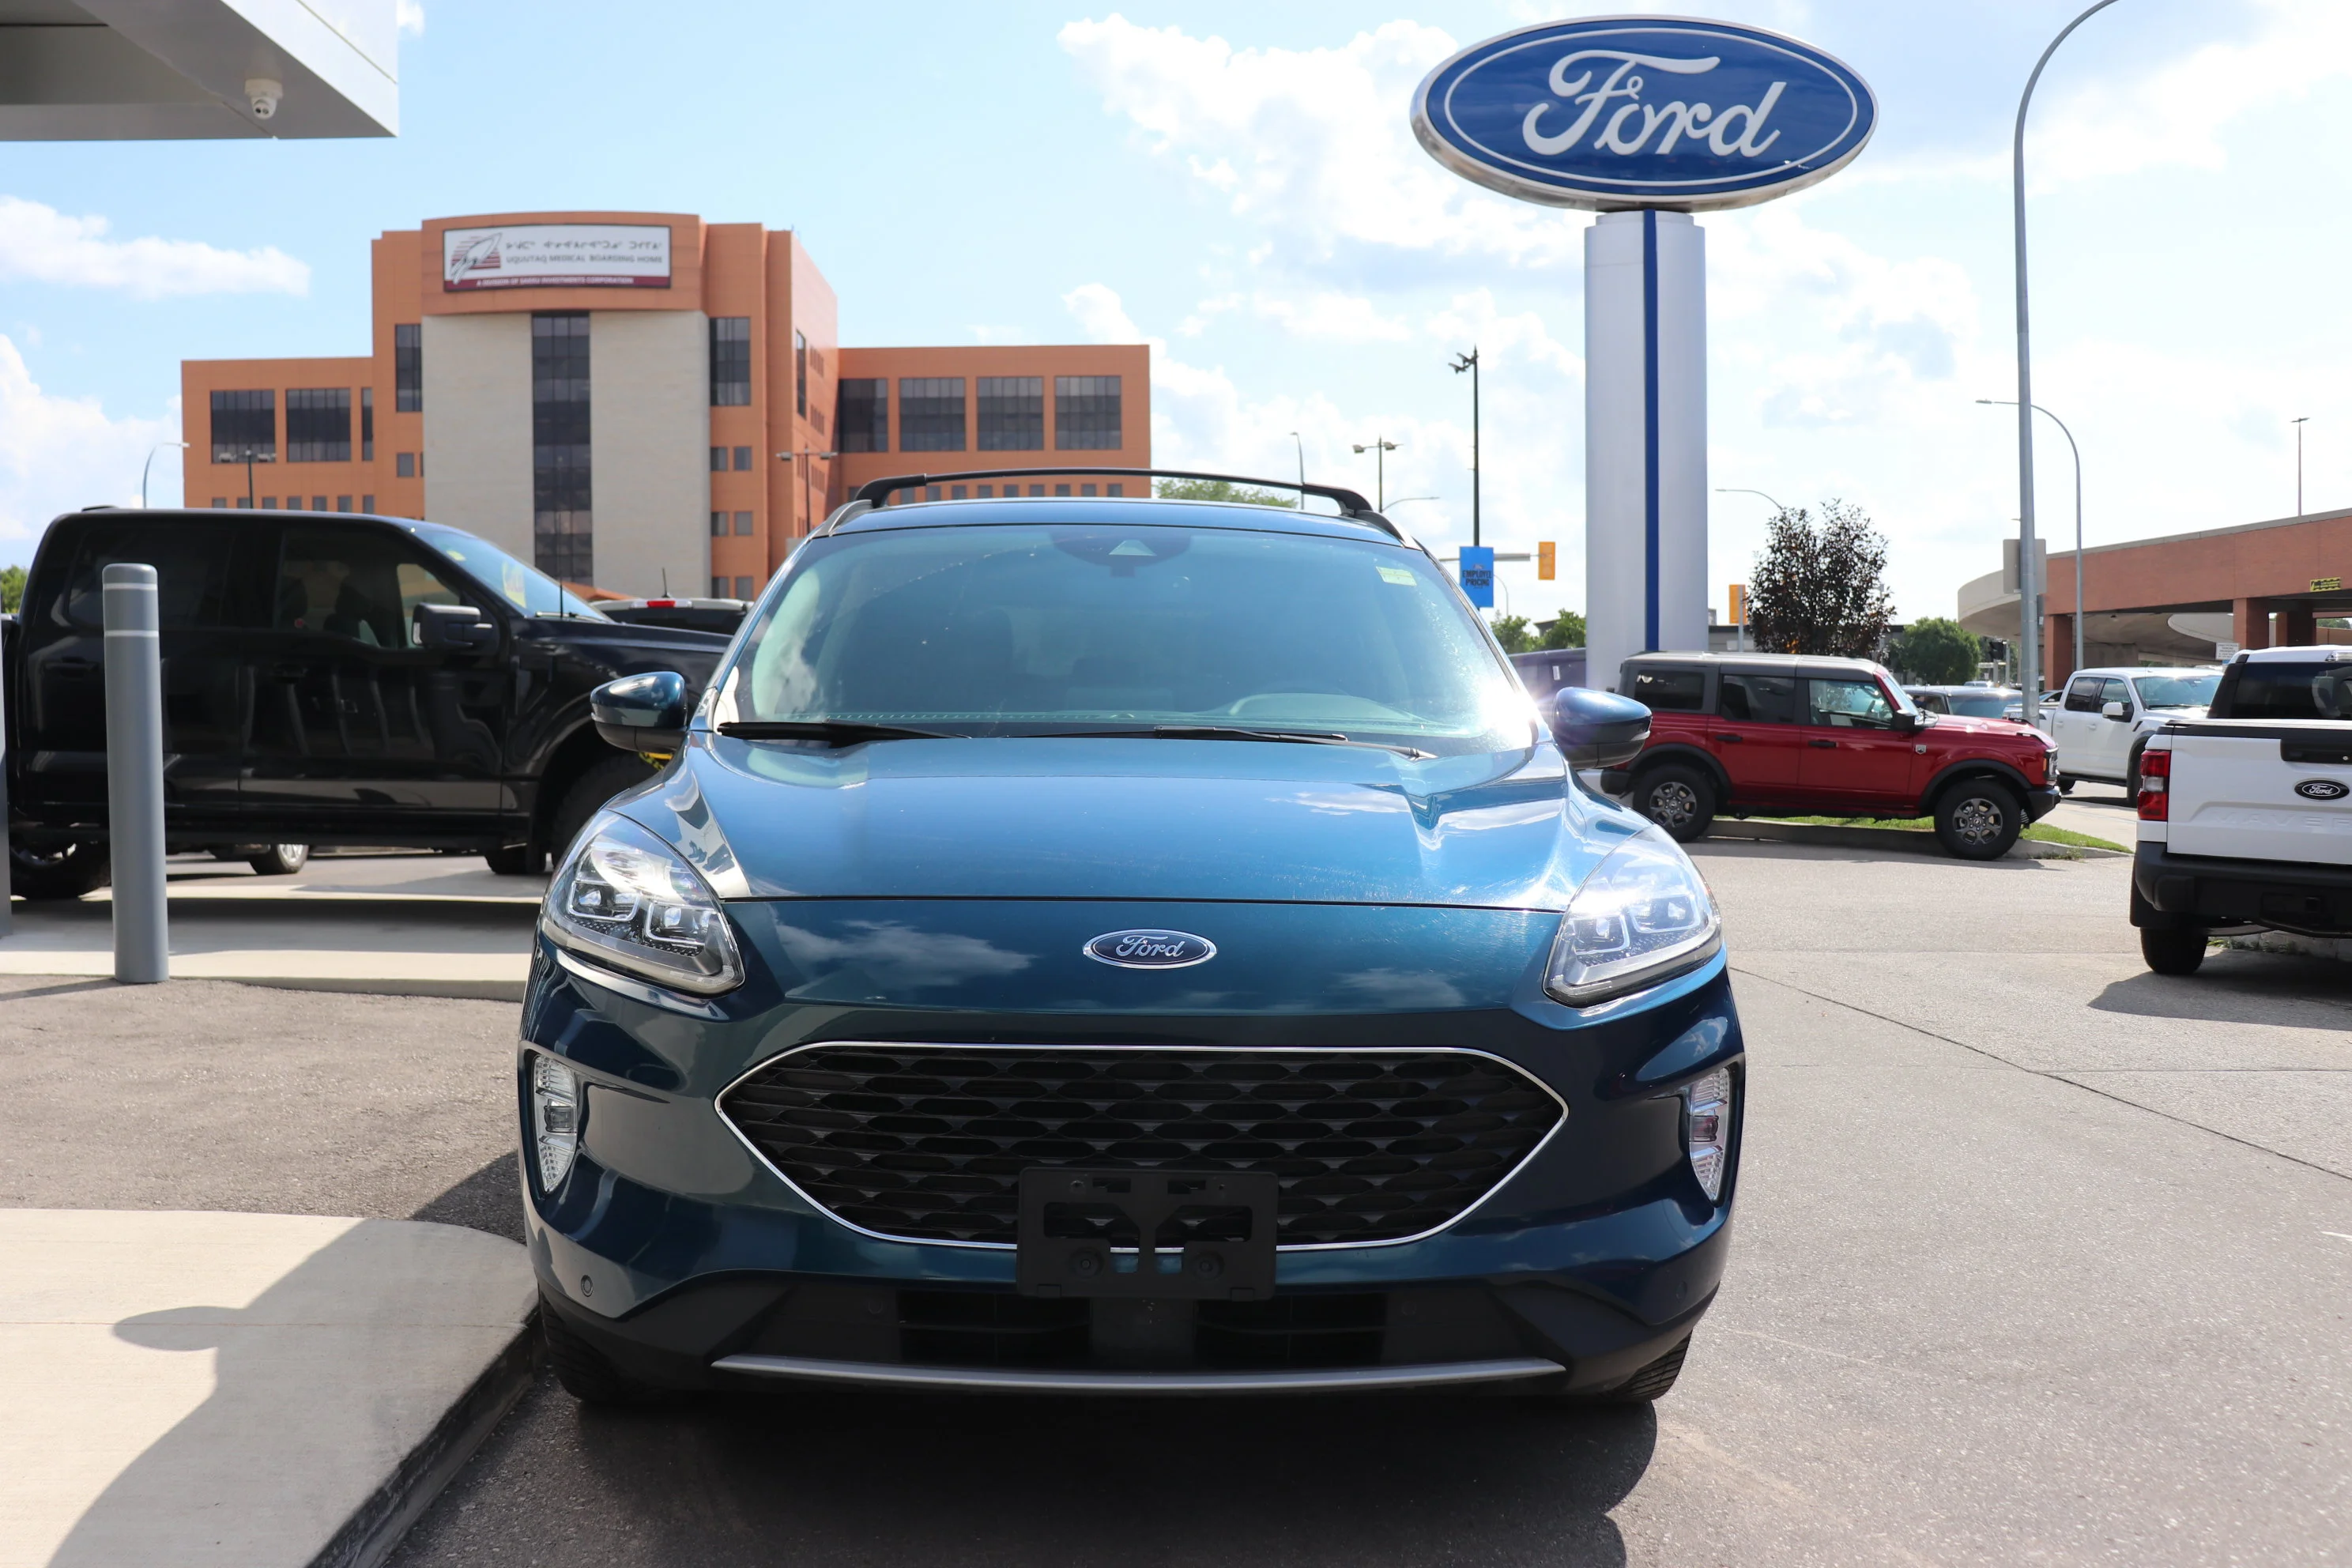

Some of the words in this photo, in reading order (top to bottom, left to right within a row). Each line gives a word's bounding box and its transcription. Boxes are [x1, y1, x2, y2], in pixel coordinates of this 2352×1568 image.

[1522, 49, 1787, 157] Ford
[549, 254, 586, 262] MEDICAL
[590, 254, 635, 263] BOARDING
[1465, 578, 1490, 586] PRICING
[2309, 783, 2333, 795] Ford
[1115, 935, 1185, 958] Ford
